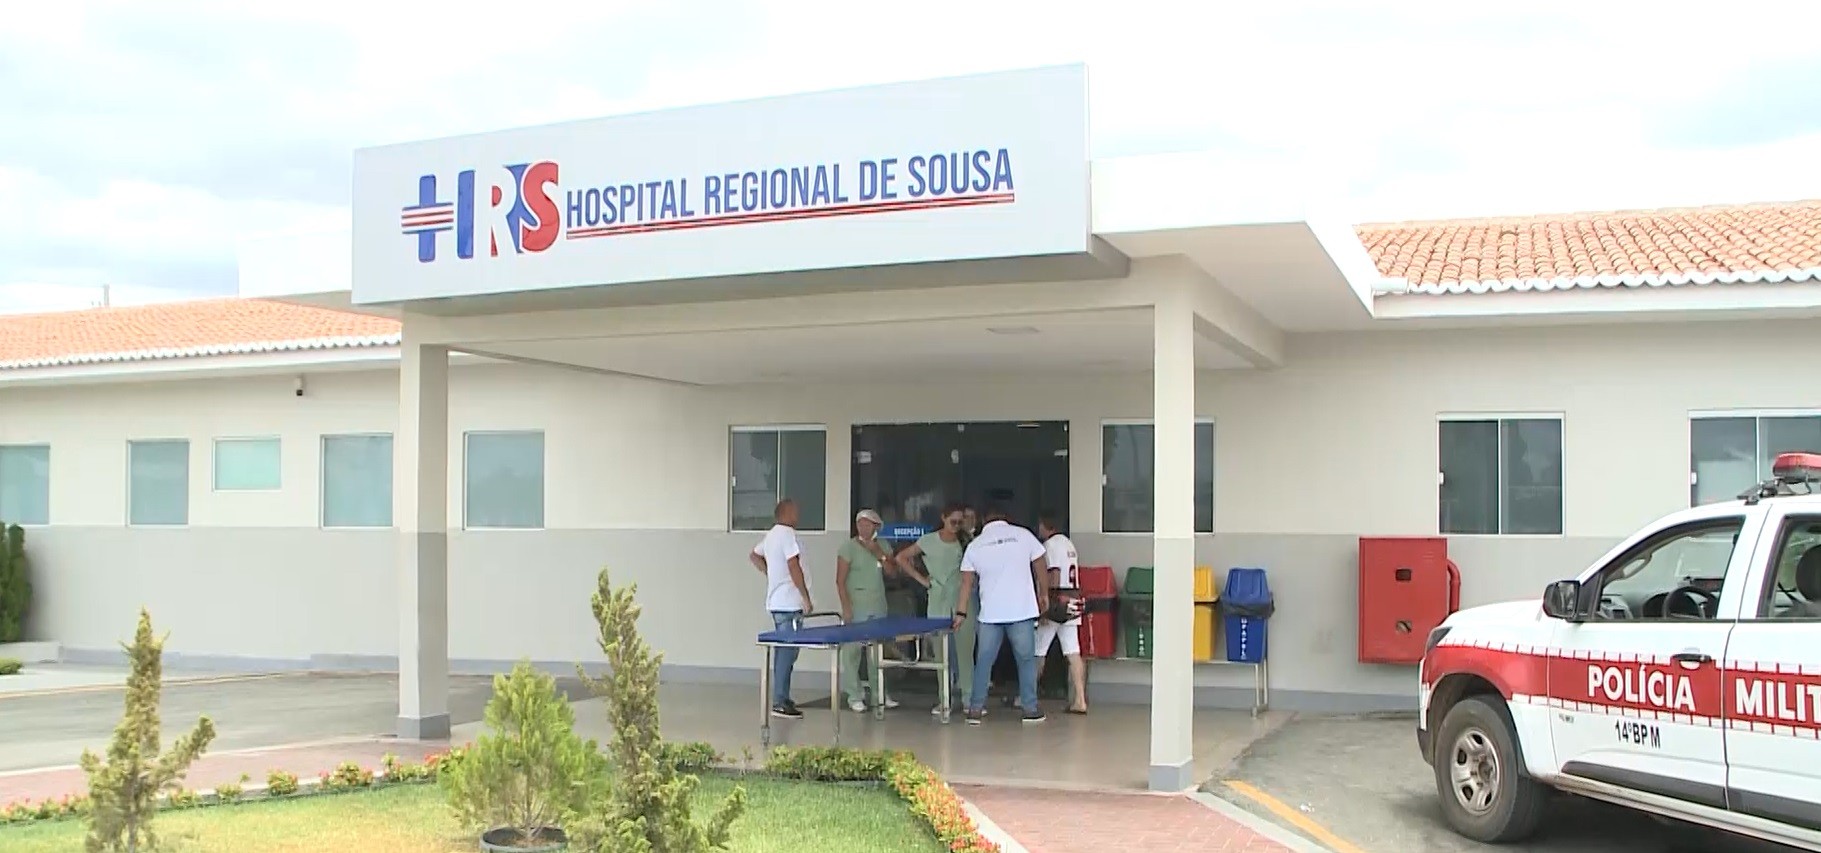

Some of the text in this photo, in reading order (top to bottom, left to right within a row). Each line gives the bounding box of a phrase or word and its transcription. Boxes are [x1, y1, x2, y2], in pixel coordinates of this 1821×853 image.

[401, 160, 560, 263] HRS
[566, 148, 1014, 229] HOSPITAL REGIONAL DE SOUSA
[1588, 664, 1821, 724] POLÍCIA MILIT
